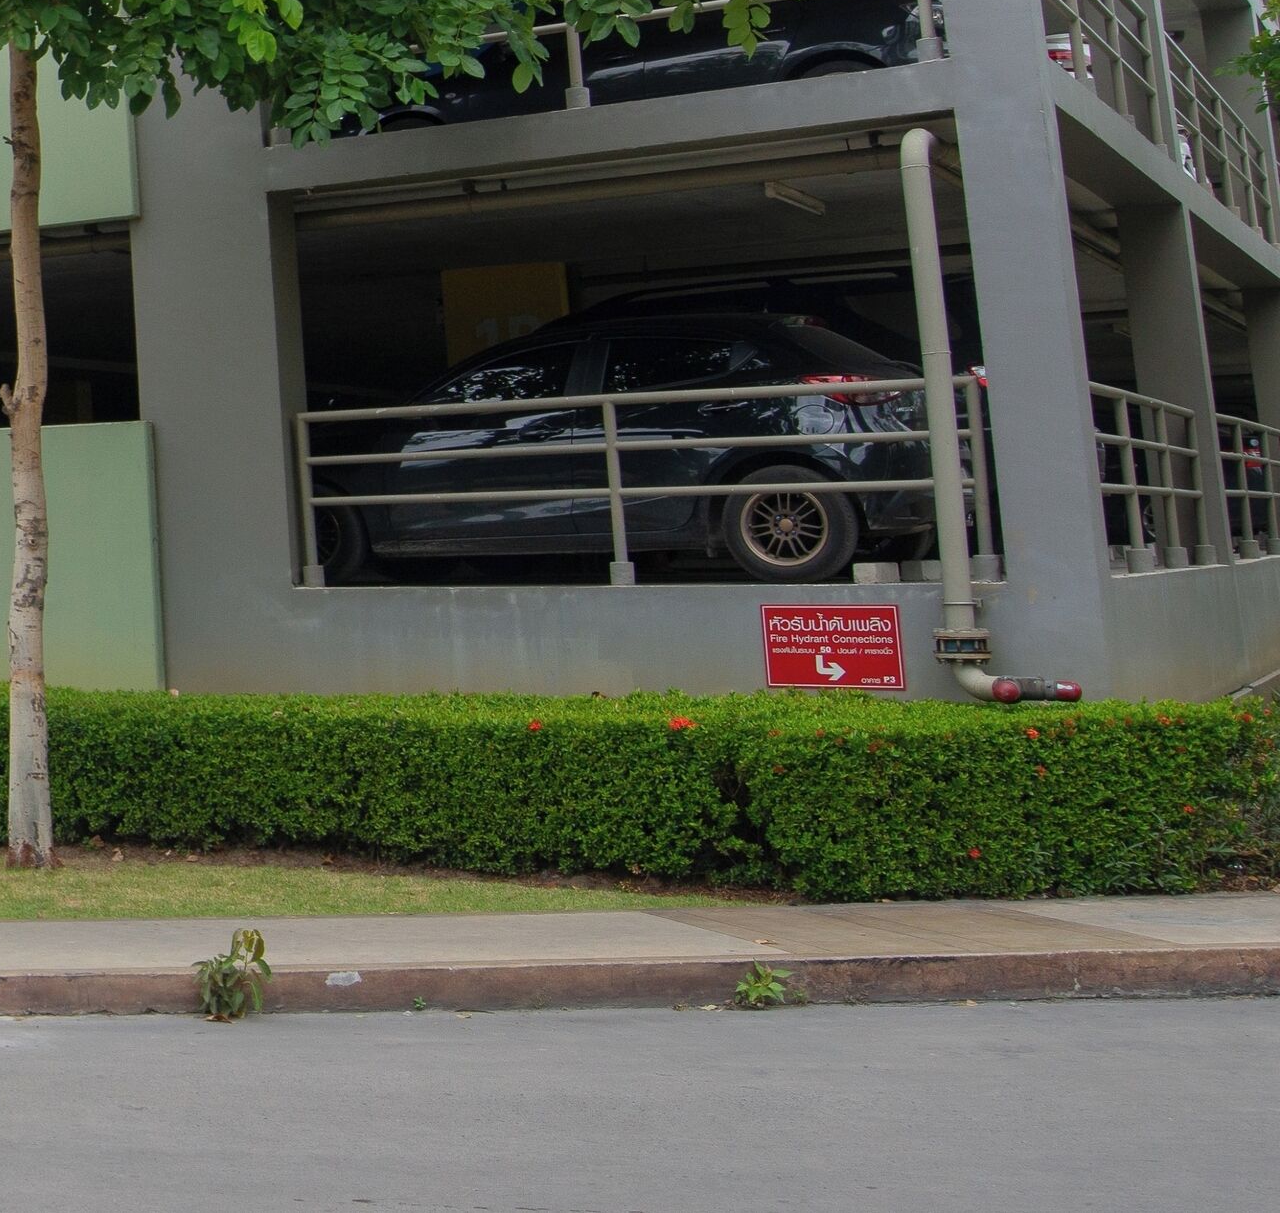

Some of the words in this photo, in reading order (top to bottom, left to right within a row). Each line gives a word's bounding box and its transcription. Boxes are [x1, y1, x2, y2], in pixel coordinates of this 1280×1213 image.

[769, 612, 892, 632] หัวรับน้ำดับเพลิง
[770, 634, 788, 643] Fire
[791, 634, 829, 644] Hydrant
[832, 634, 893, 644] Connections
[820, 646, 832, 654] 50
[883, 676, 896, 684] P3
